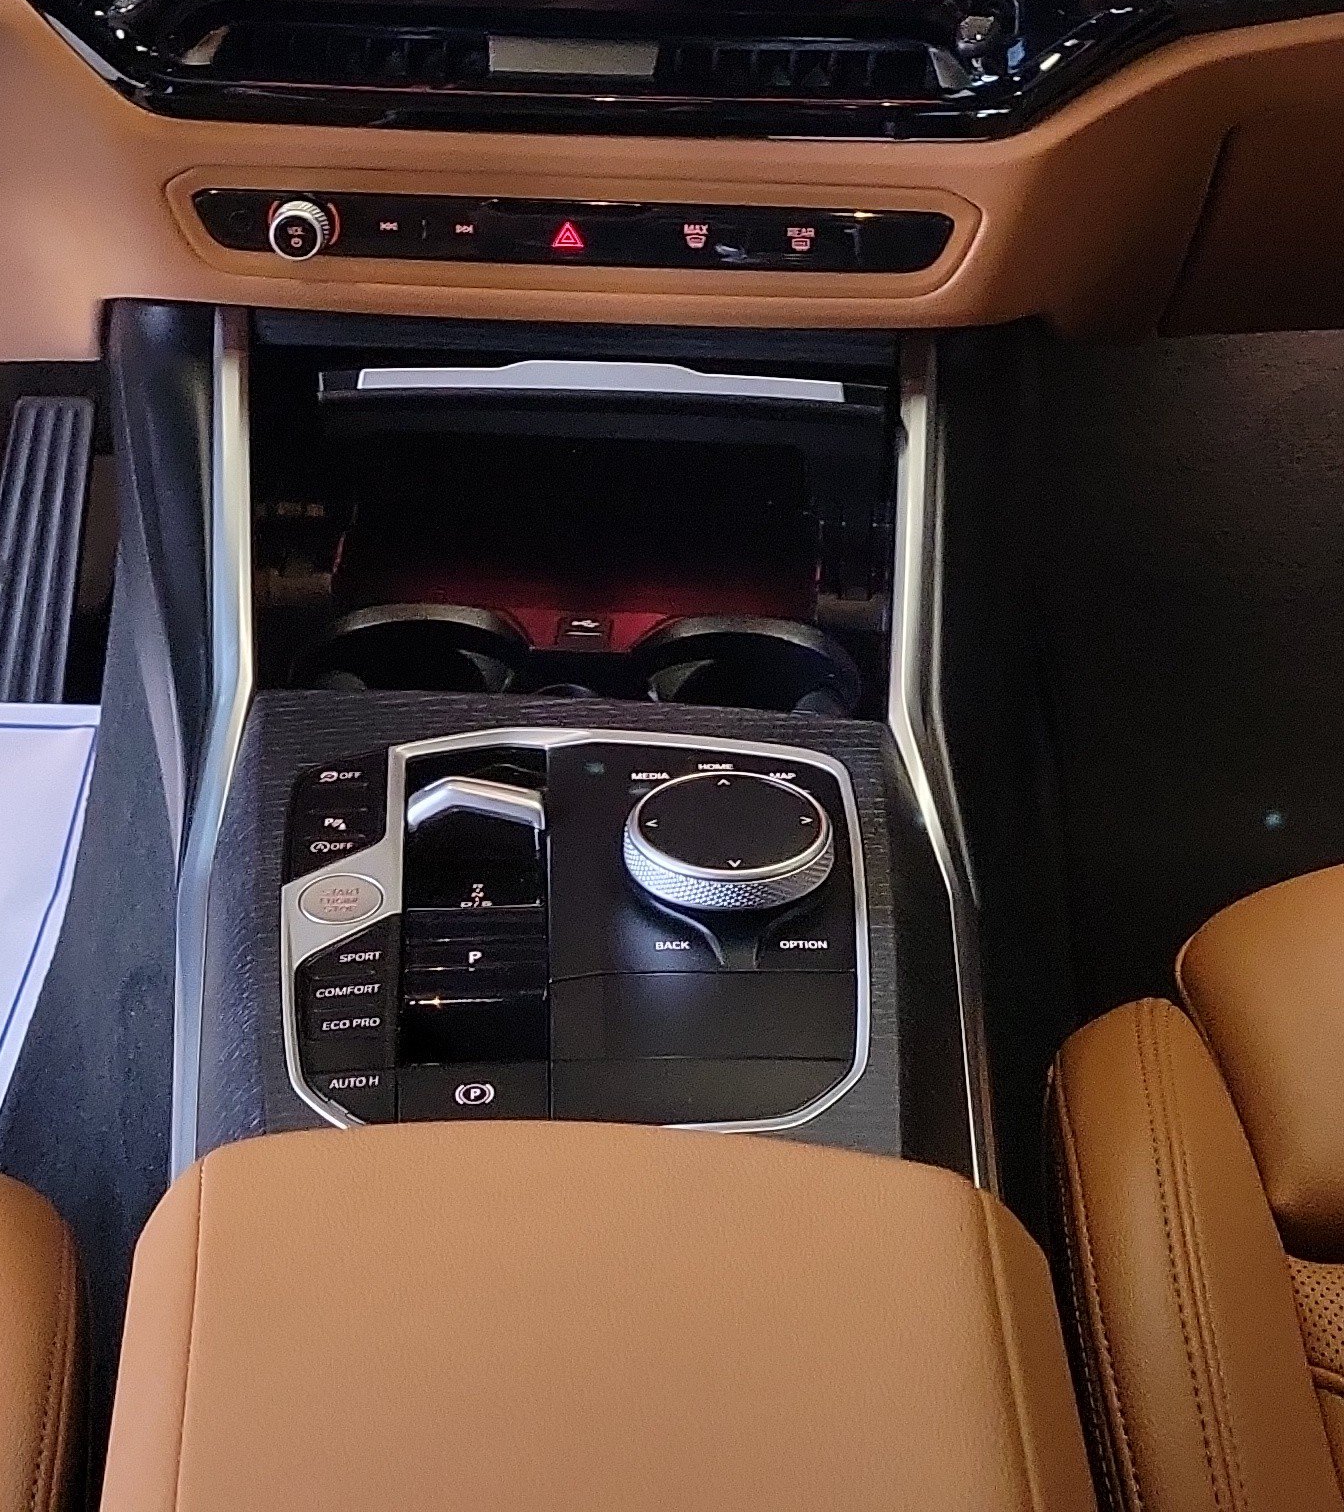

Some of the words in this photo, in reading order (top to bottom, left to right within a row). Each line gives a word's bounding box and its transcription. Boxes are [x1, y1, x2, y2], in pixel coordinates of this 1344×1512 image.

[697, 763, 735, 771] HOME
[339, 771, 363, 780] OFF
[631, 772, 671, 781] MEDIA
[769, 772, 797, 780] MAP
[330, 842, 354, 851] OFF
[655, 940, 690, 950] BACK
[779, 940, 828, 950] OPTION
[338, 951, 382, 963] SPORT
[468, 951, 483, 964] P
[315, 983, 382, 998] COMFORT
[321, 1019, 350, 1031] ECO
[351, 1017, 381, 1029] PRO
[328, 1077, 367, 1089] AUTO
[368, 1075, 380, 1087] H
